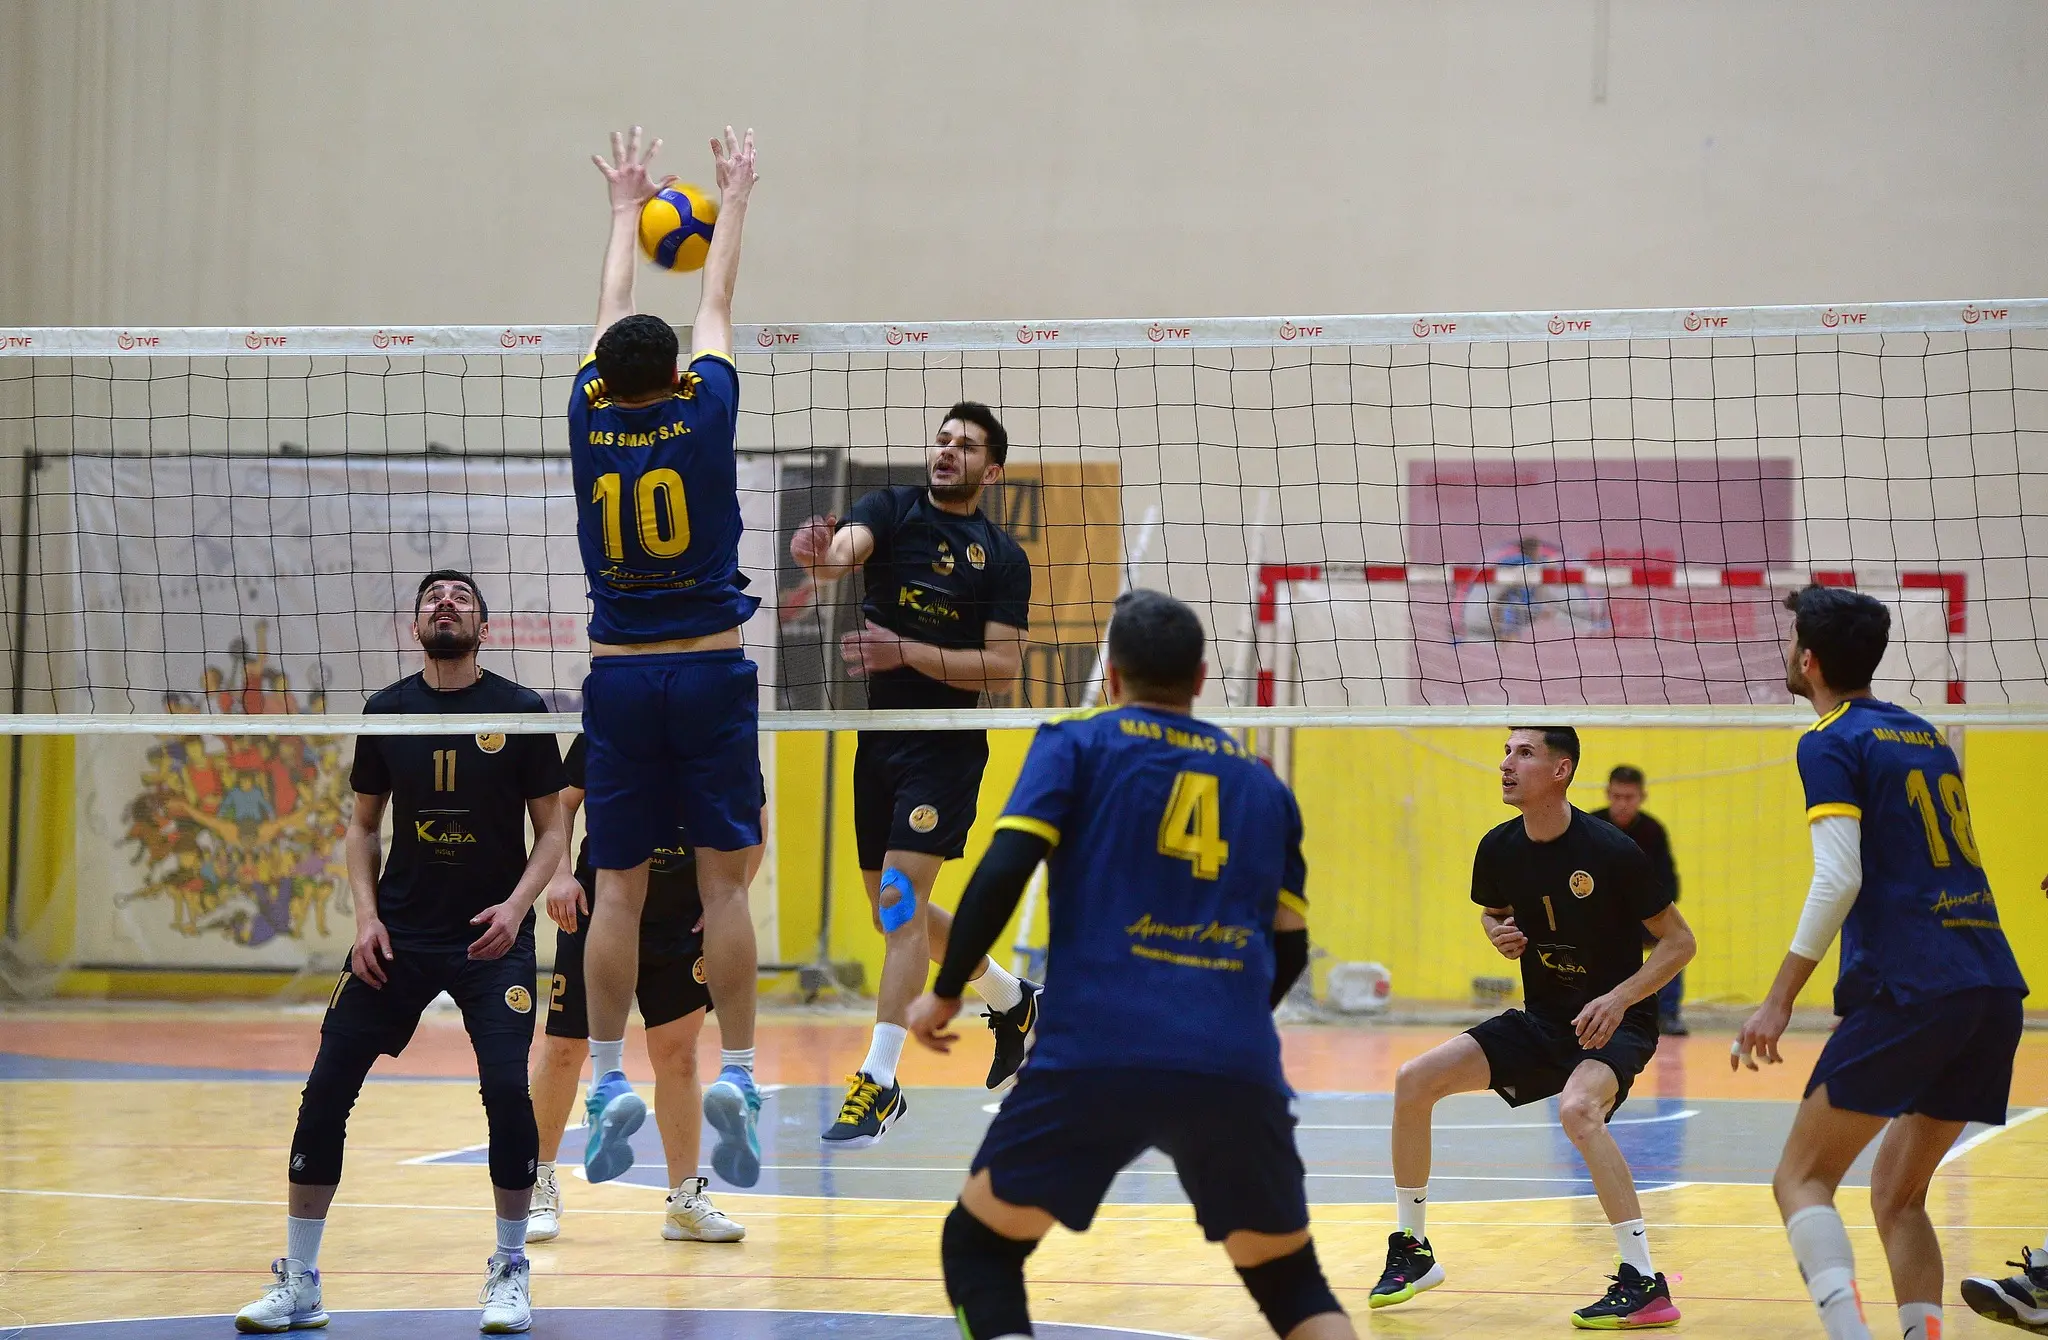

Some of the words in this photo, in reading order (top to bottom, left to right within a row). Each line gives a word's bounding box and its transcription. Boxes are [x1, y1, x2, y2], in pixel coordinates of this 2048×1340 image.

[1841, 313, 1867, 324] TVF
[1984, 309, 2009, 320] TVF
[1567, 320, 1592, 330] TVF
[1704, 317, 1729, 327] TVF
[1168, 328, 1191, 338] TVF
[1299, 327, 1322, 337] TVF
[1433, 323, 1457, 333] TVF
[520, 335, 542, 345] TVF
[776, 334, 800, 344] TVF
[906, 332, 930, 342] TVF
[1036, 330, 1059, 340] TVF
[9, 337, 32, 346] TVF
[137, 337, 160, 346] TVF
[265, 336, 287, 346] TVF
[392, 336, 414, 345] TVF
[659, 421, 691, 441] S.K.
[592, 468, 691, 563] 10
[1120, 719, 1162, 740] MAS
[433, 750, 456, 791] 11
[1905, 769, 1982, 868] 18
[1157, 770, 1228, 881] 4
[415, 820, 477, 843] KARA
[1542, 896, 1556, 931] 1
[1537, 949, 1588, 974] KARA
